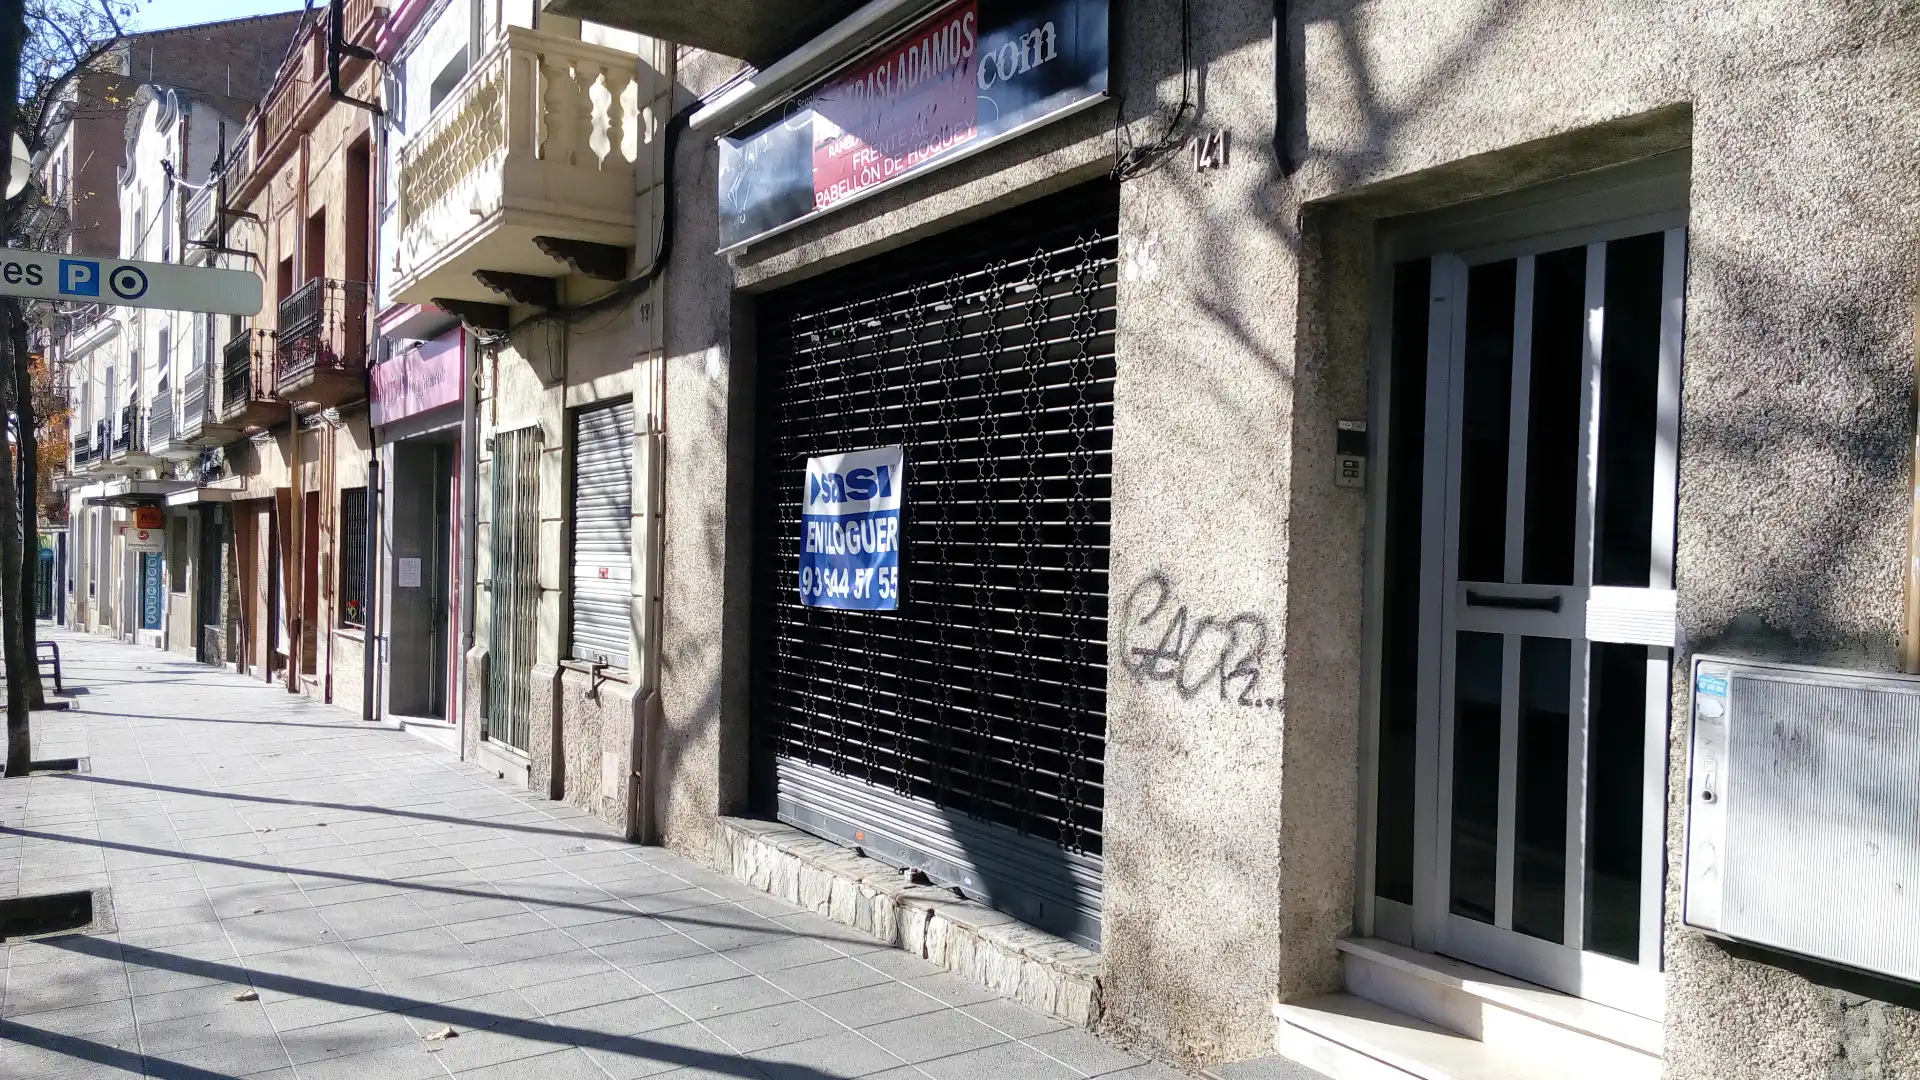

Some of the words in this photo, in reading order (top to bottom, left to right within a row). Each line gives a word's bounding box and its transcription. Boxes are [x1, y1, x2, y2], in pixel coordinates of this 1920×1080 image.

[815, 166, 881, 206] PABELLÓN
[884, 152, 904, 176] DE
[907, 116, 976, 164] HOQUEY
[852, 128, 907, 170] FRENTE
[1189, 129, 1223, 171] 141
[802, 566, 823, 597] 93
[879, 566, 898, 599] 55
